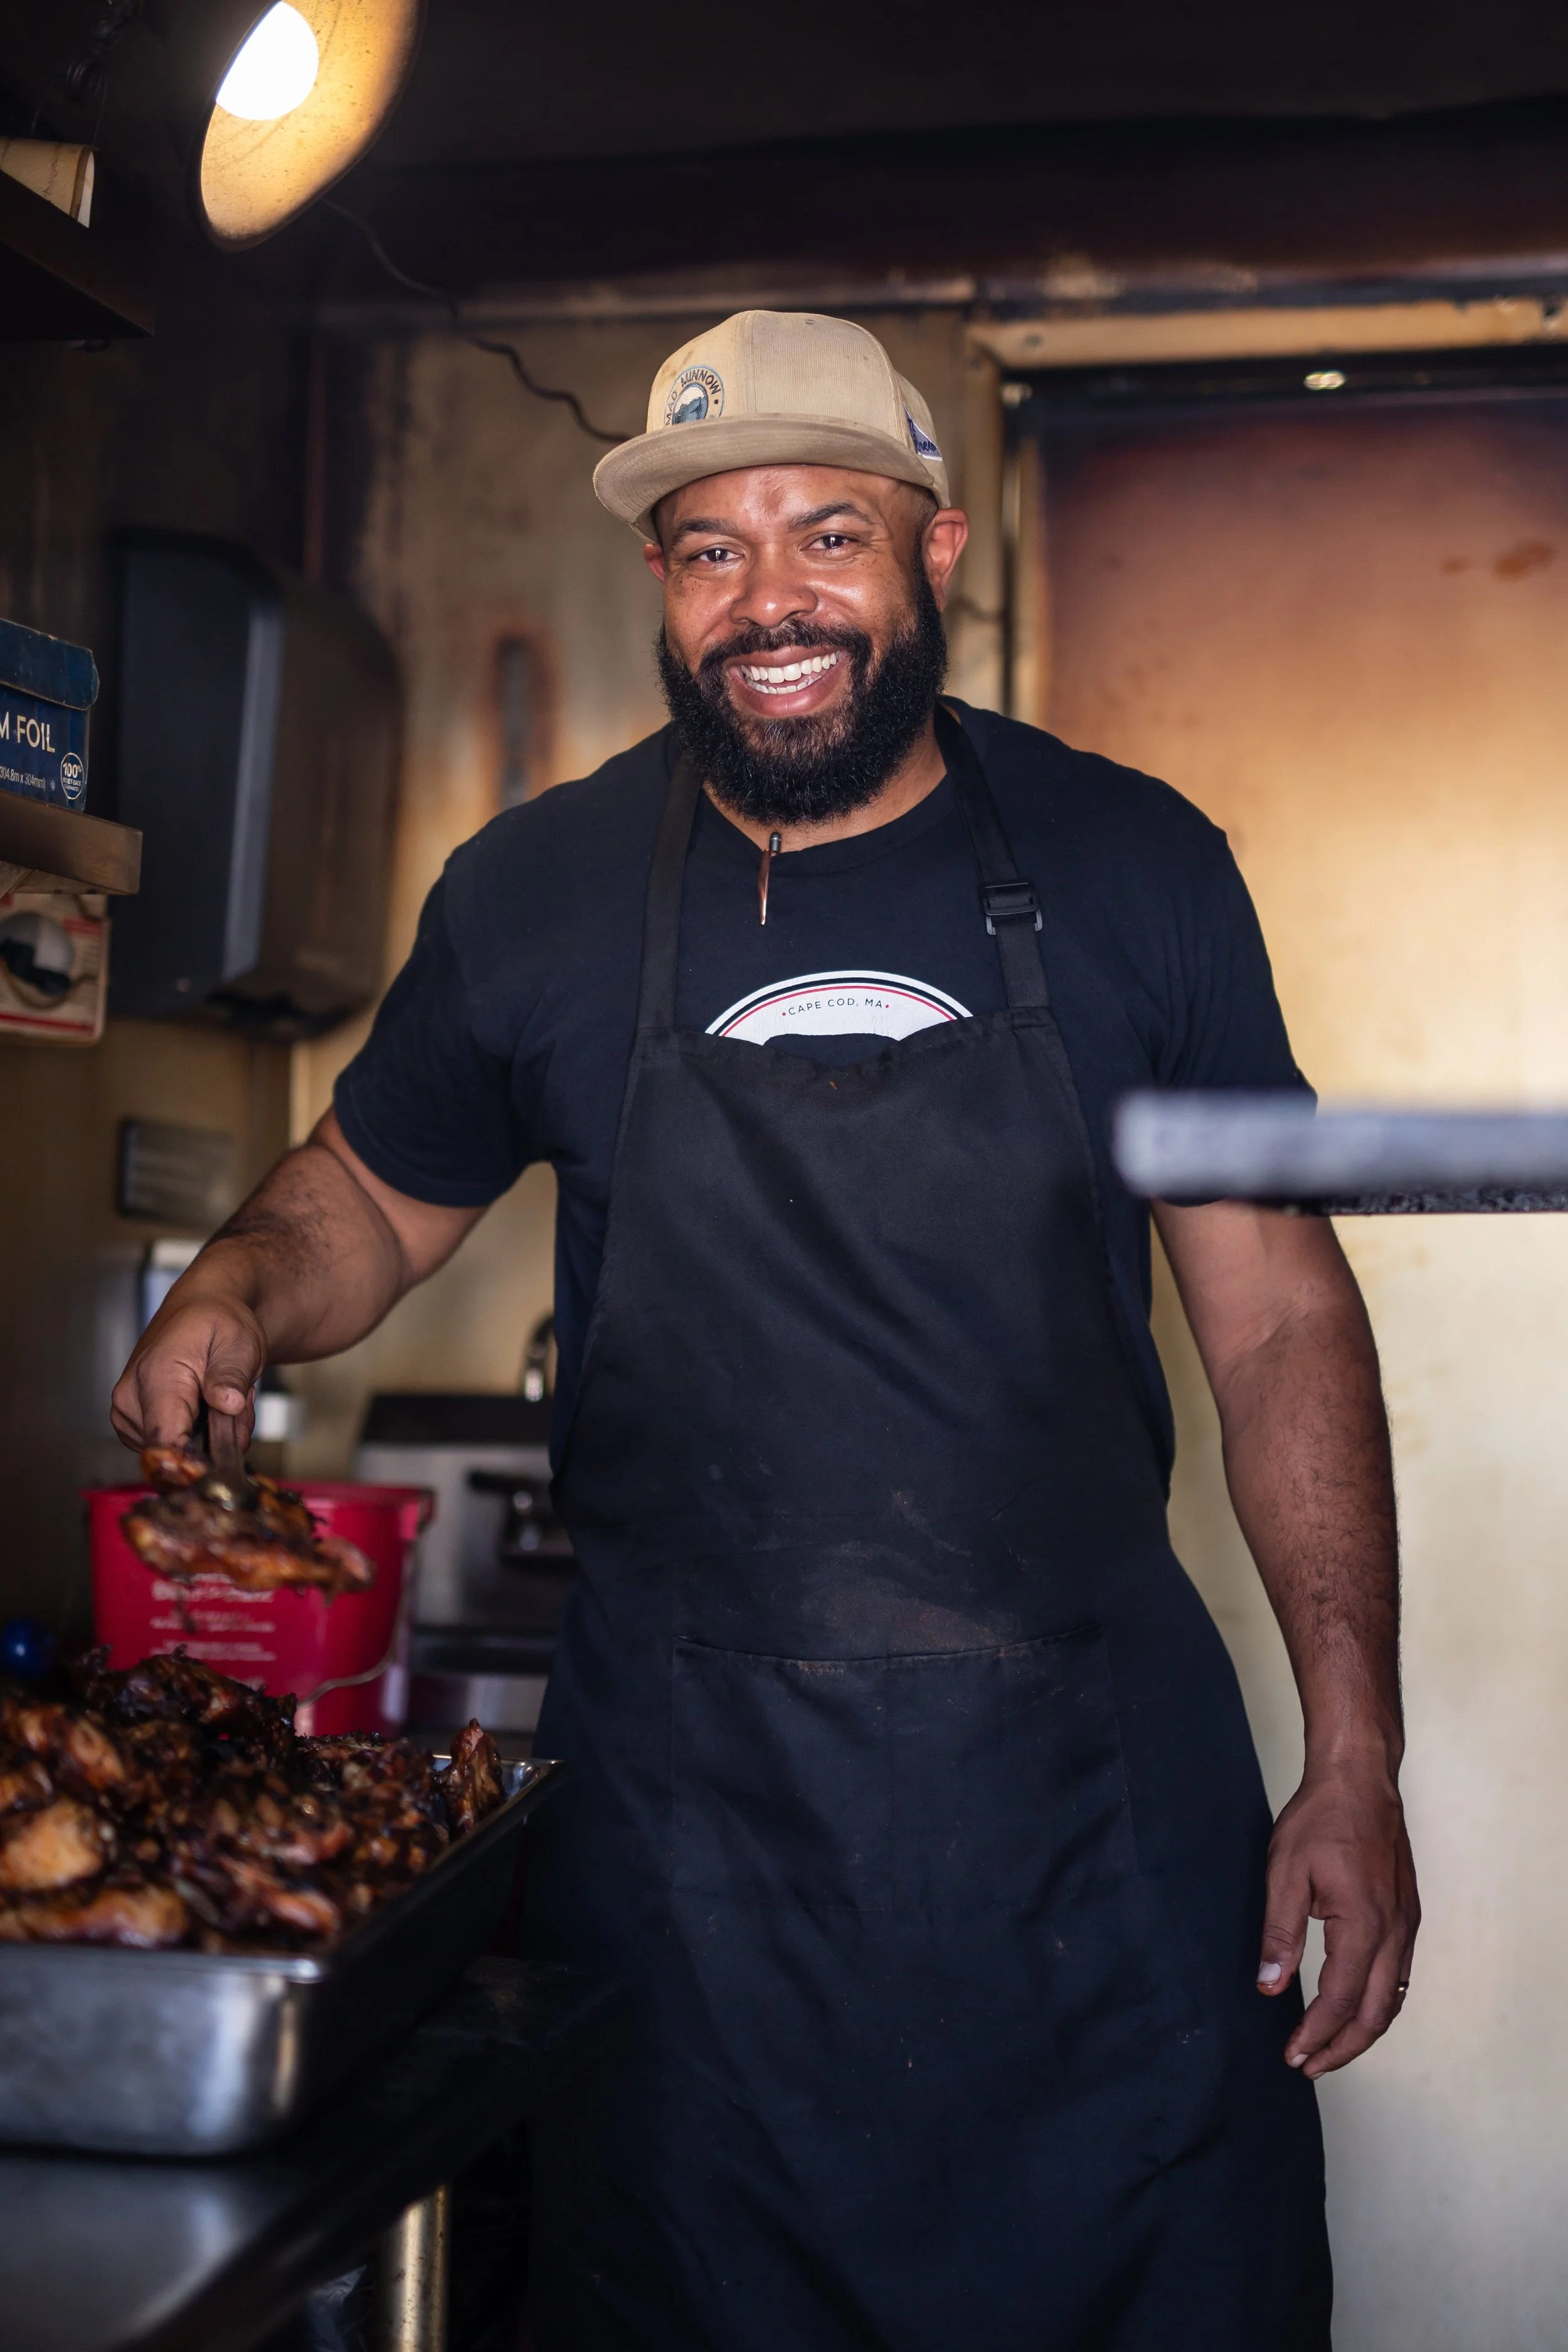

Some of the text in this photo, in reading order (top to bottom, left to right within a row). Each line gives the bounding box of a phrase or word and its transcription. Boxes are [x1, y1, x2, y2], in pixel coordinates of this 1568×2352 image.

[17, 714, 55, 753] FOIL
[63, 762, 82, 778] 100%
[20, 773, 24, 784] x
[24, 773, 46, 792] 304mm)
[788, 998, 882, 1015] CAPE COD, MA
